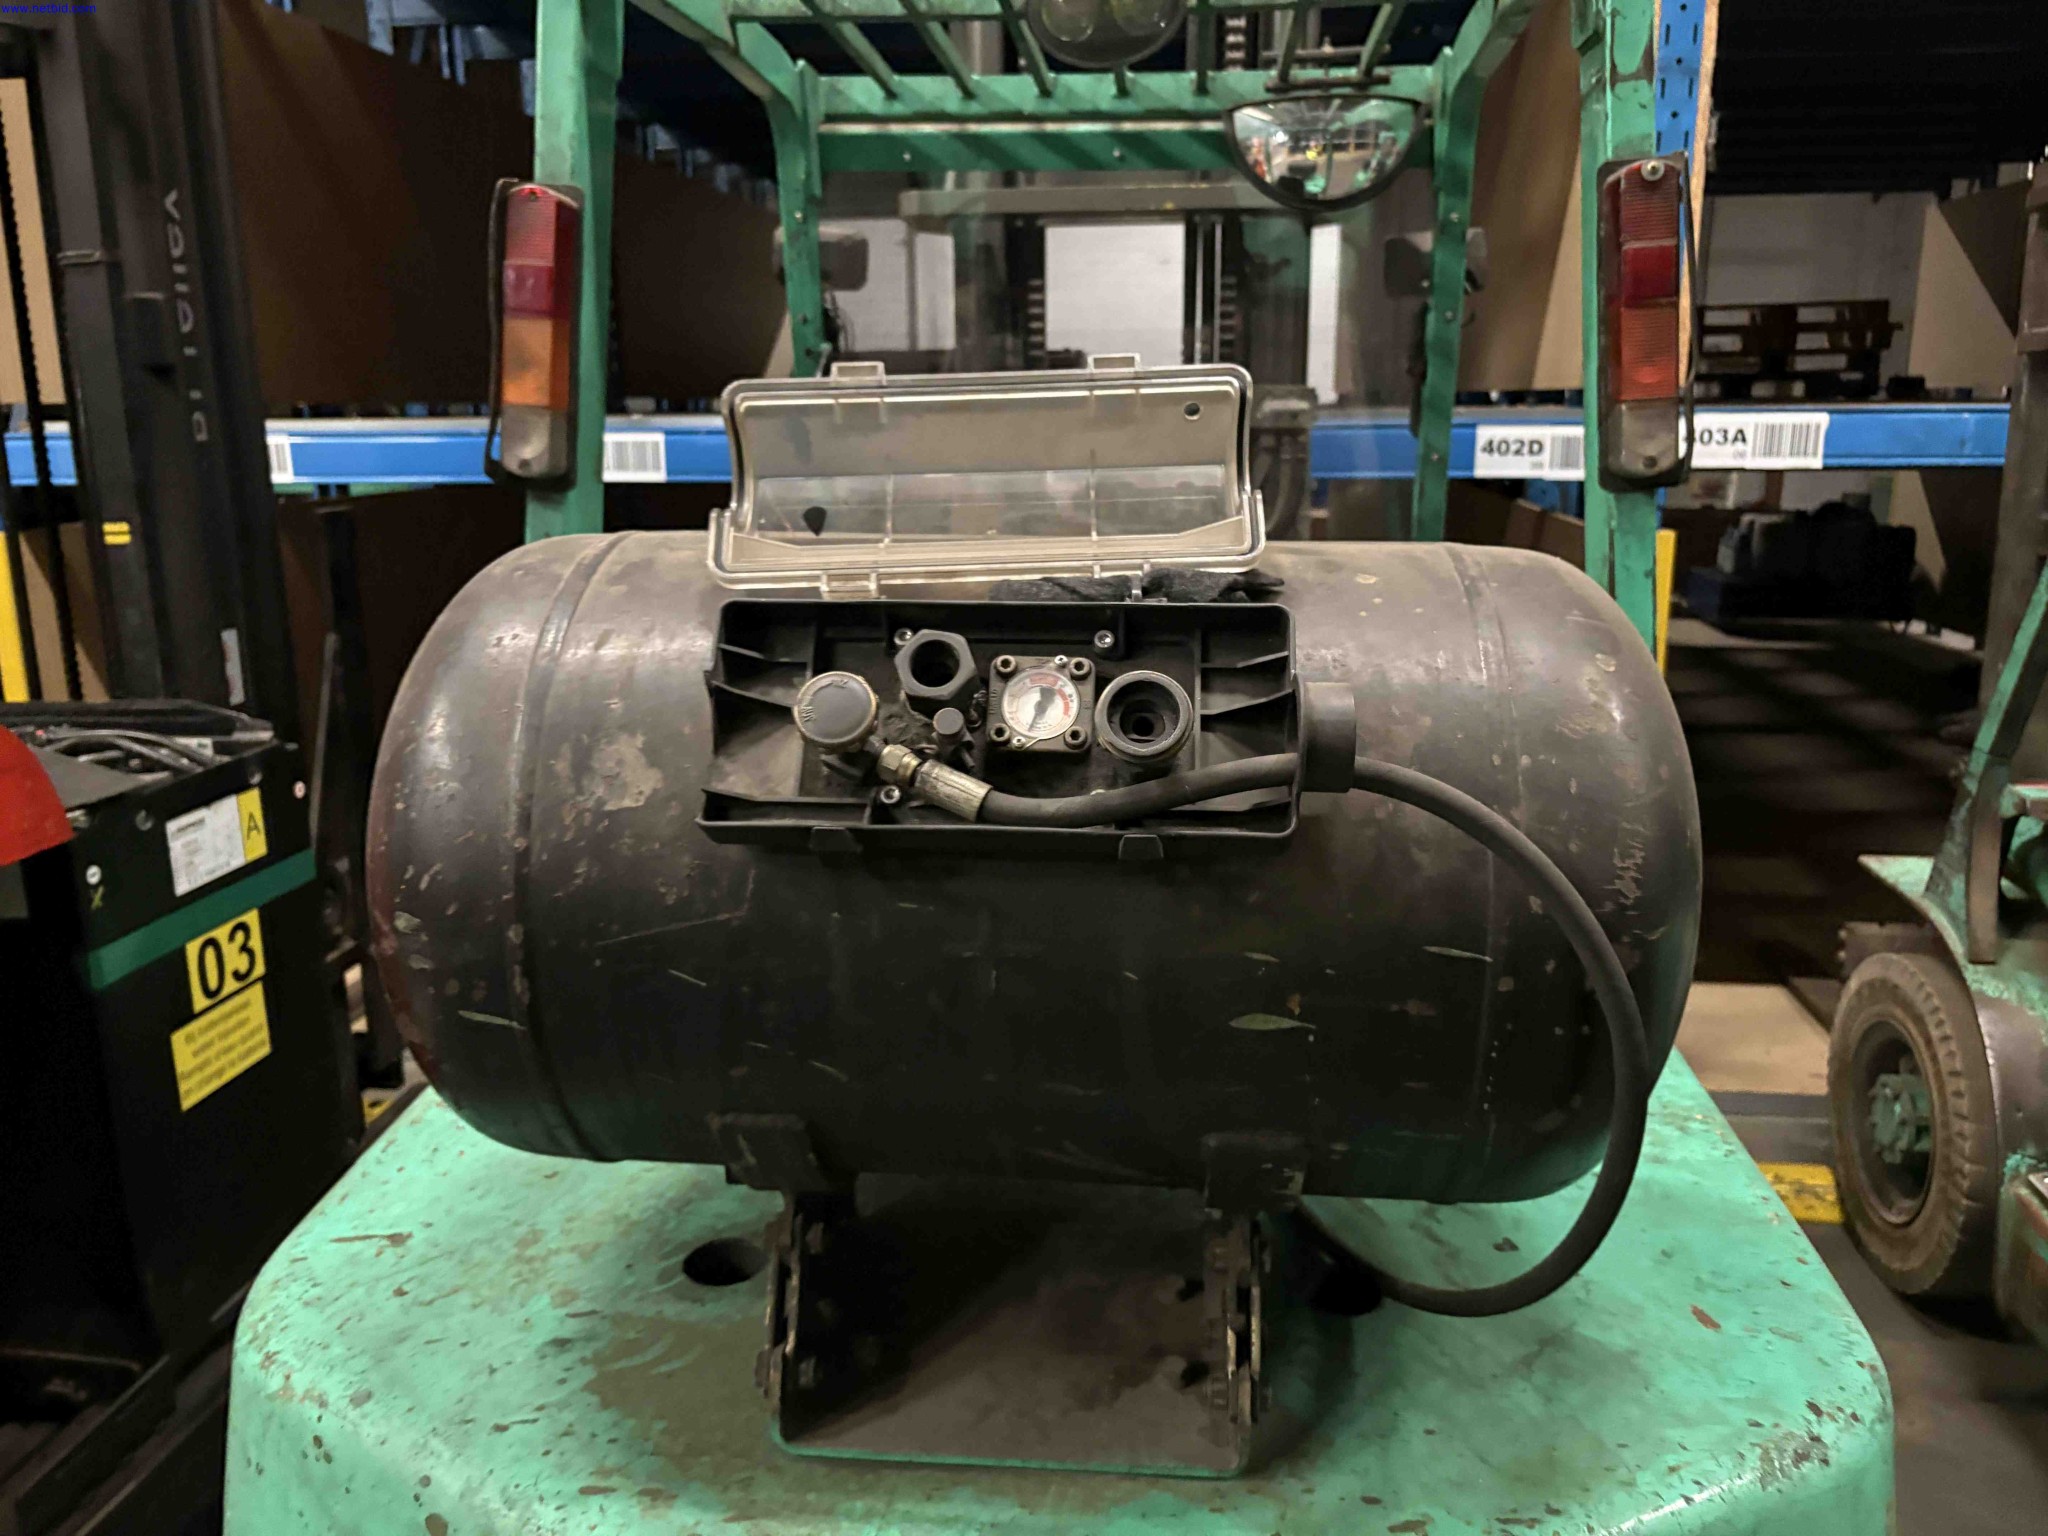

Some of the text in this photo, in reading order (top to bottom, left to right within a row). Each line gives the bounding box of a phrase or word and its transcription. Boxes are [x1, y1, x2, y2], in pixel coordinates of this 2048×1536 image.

[1480, 437, 1544, 457] 402D
[1682, 428, 1747, 446] 03A
[246, 811, 261, 841] A
[197, 921, 256, 1000] 03
